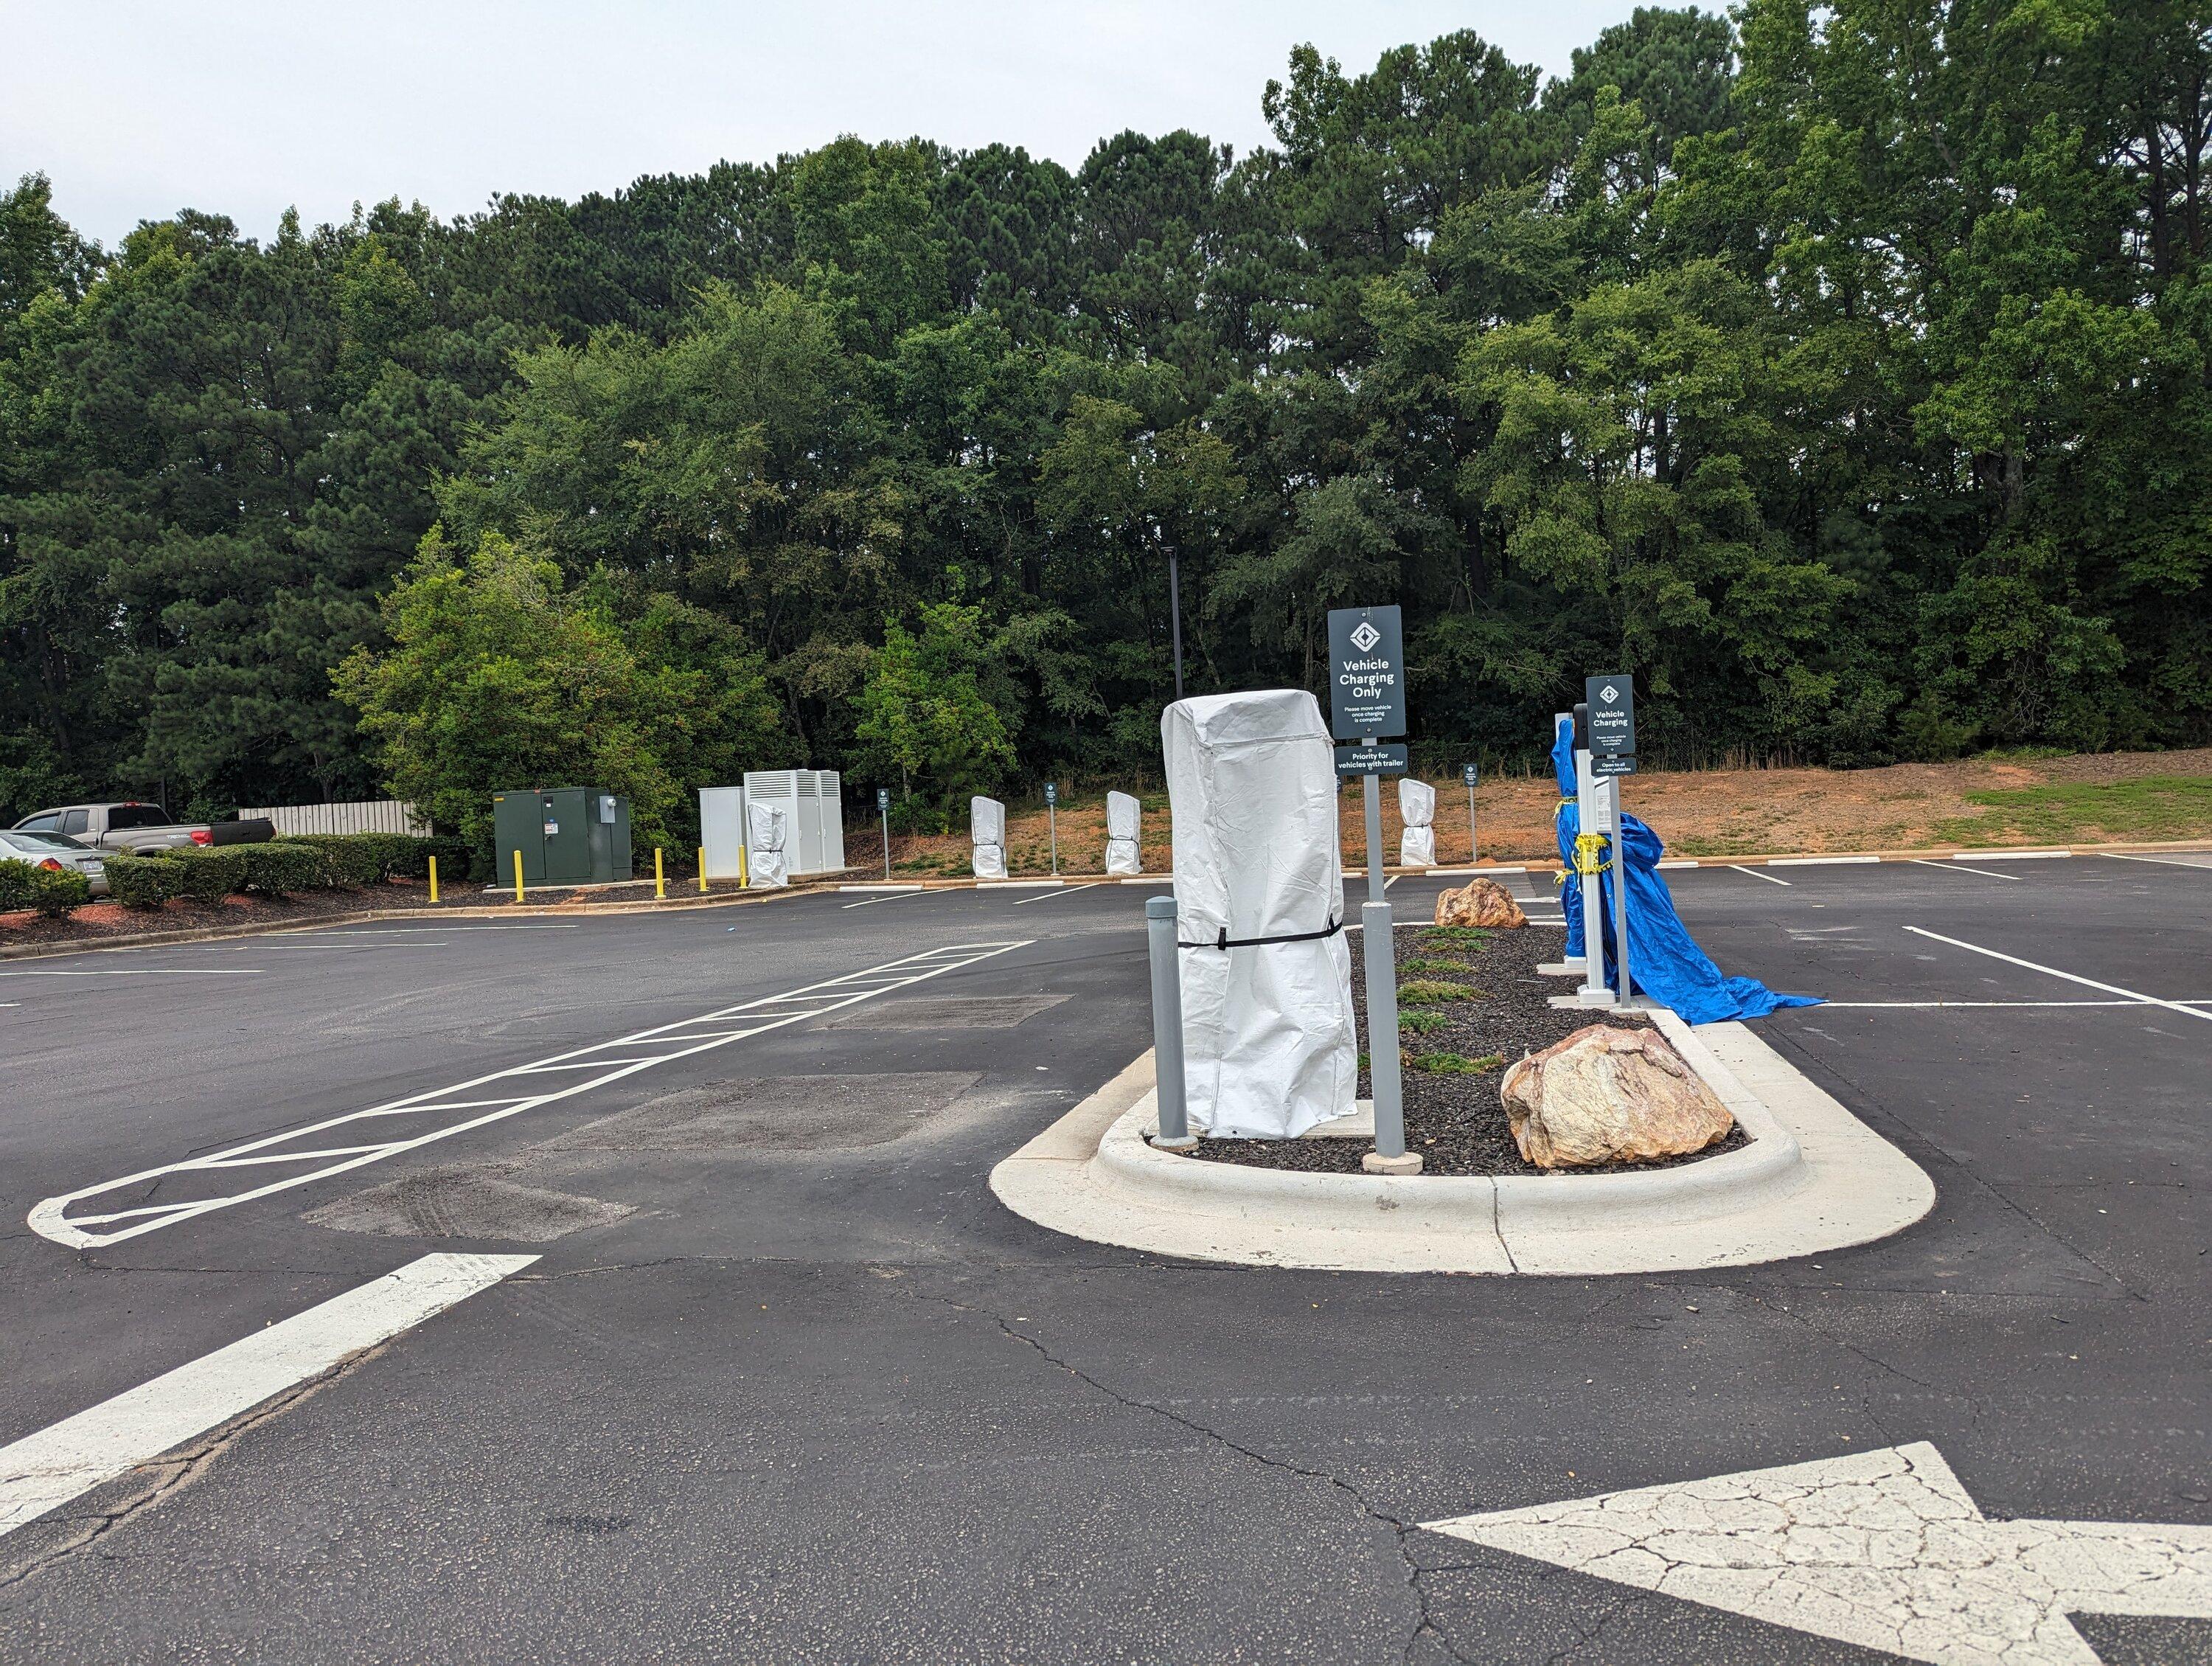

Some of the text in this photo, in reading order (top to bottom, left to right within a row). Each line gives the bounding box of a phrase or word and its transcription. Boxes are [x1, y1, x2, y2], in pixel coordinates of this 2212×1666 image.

[1343, 659, 1389, 671] Vehicle
[1339, 672, 1394, 686] Charging
[1353, 686, 1382, 699] Only
[1596, 710, 1624, 718] Vehicle
[1593, 718, 1628, 727] Charging
